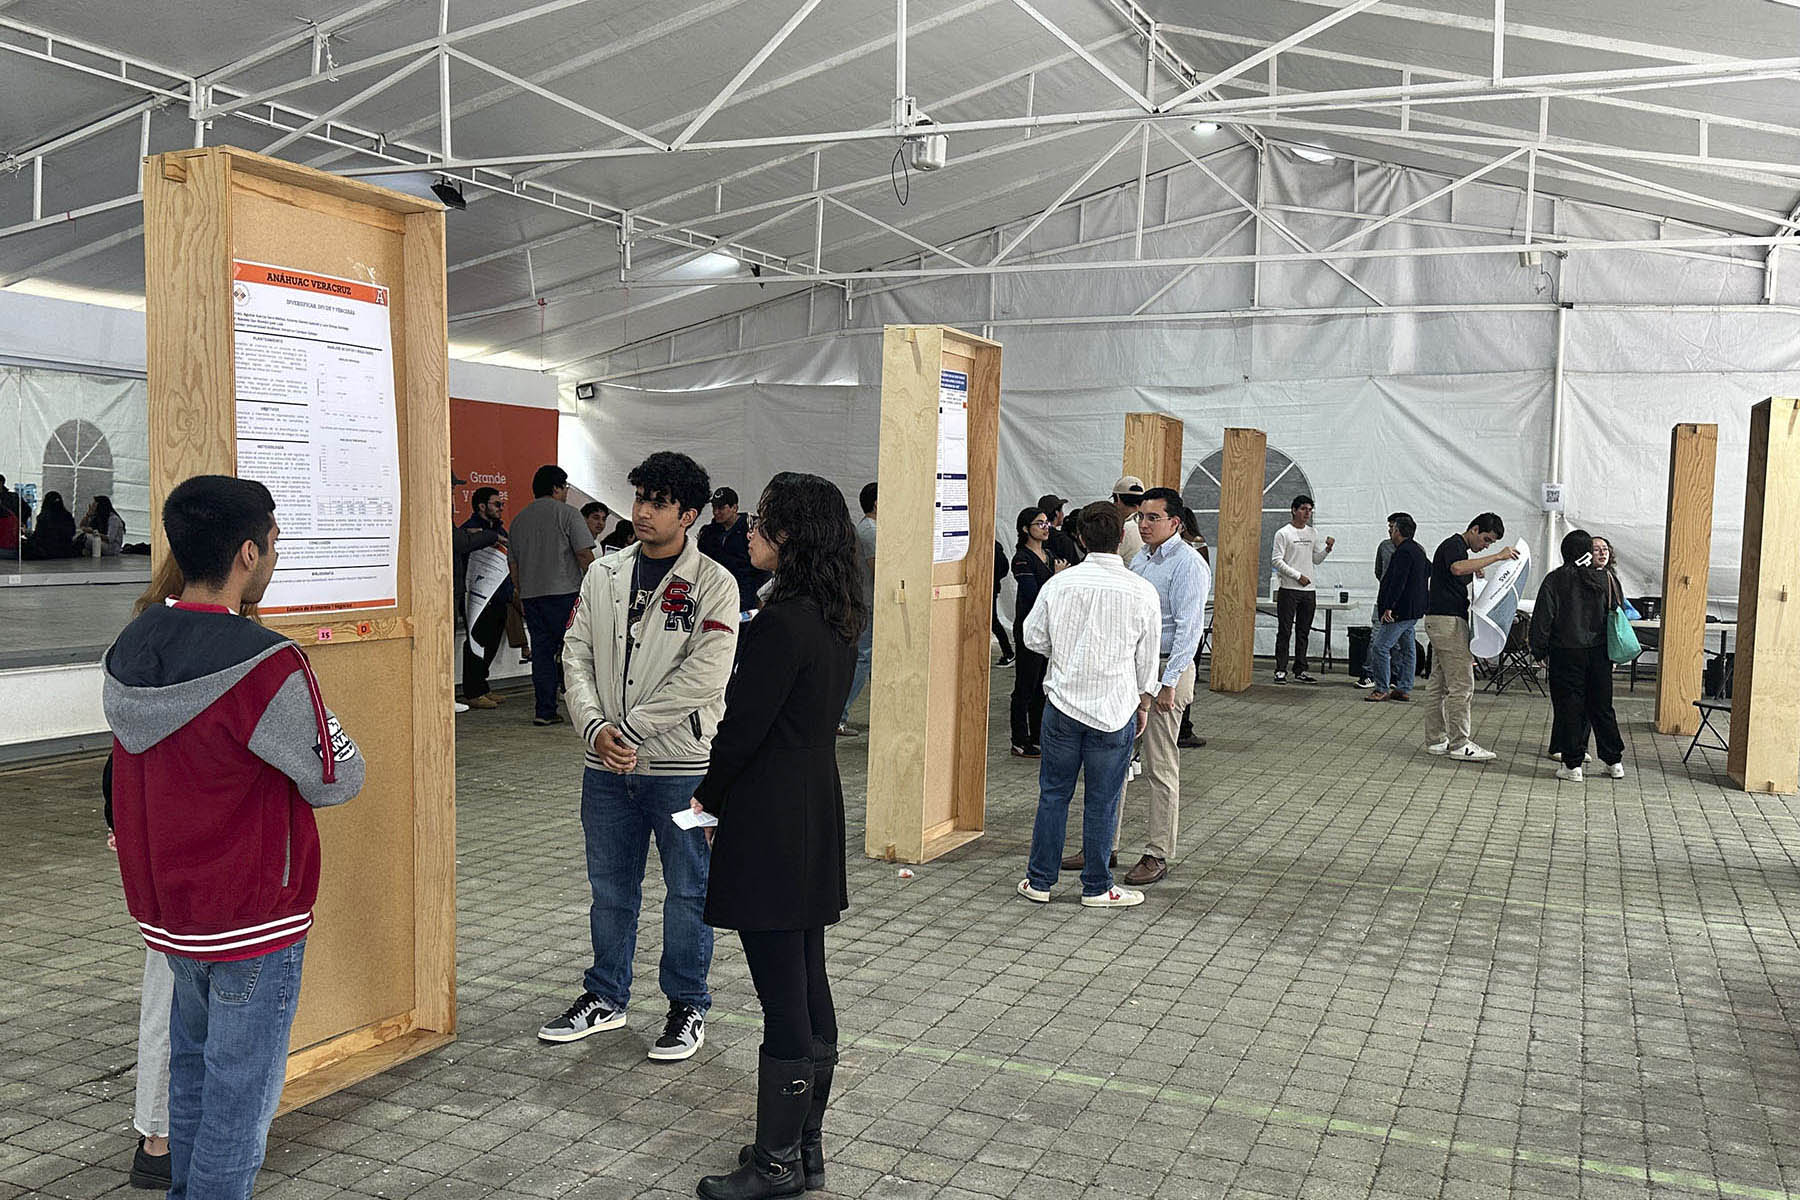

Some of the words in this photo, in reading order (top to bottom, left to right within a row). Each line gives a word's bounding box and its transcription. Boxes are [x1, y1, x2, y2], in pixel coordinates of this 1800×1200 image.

[266, 272, 310, 287] ANÁHUAC
[311, 280, 352, 295] VERACRUZ
[470, 471, 507, 485] Grande
